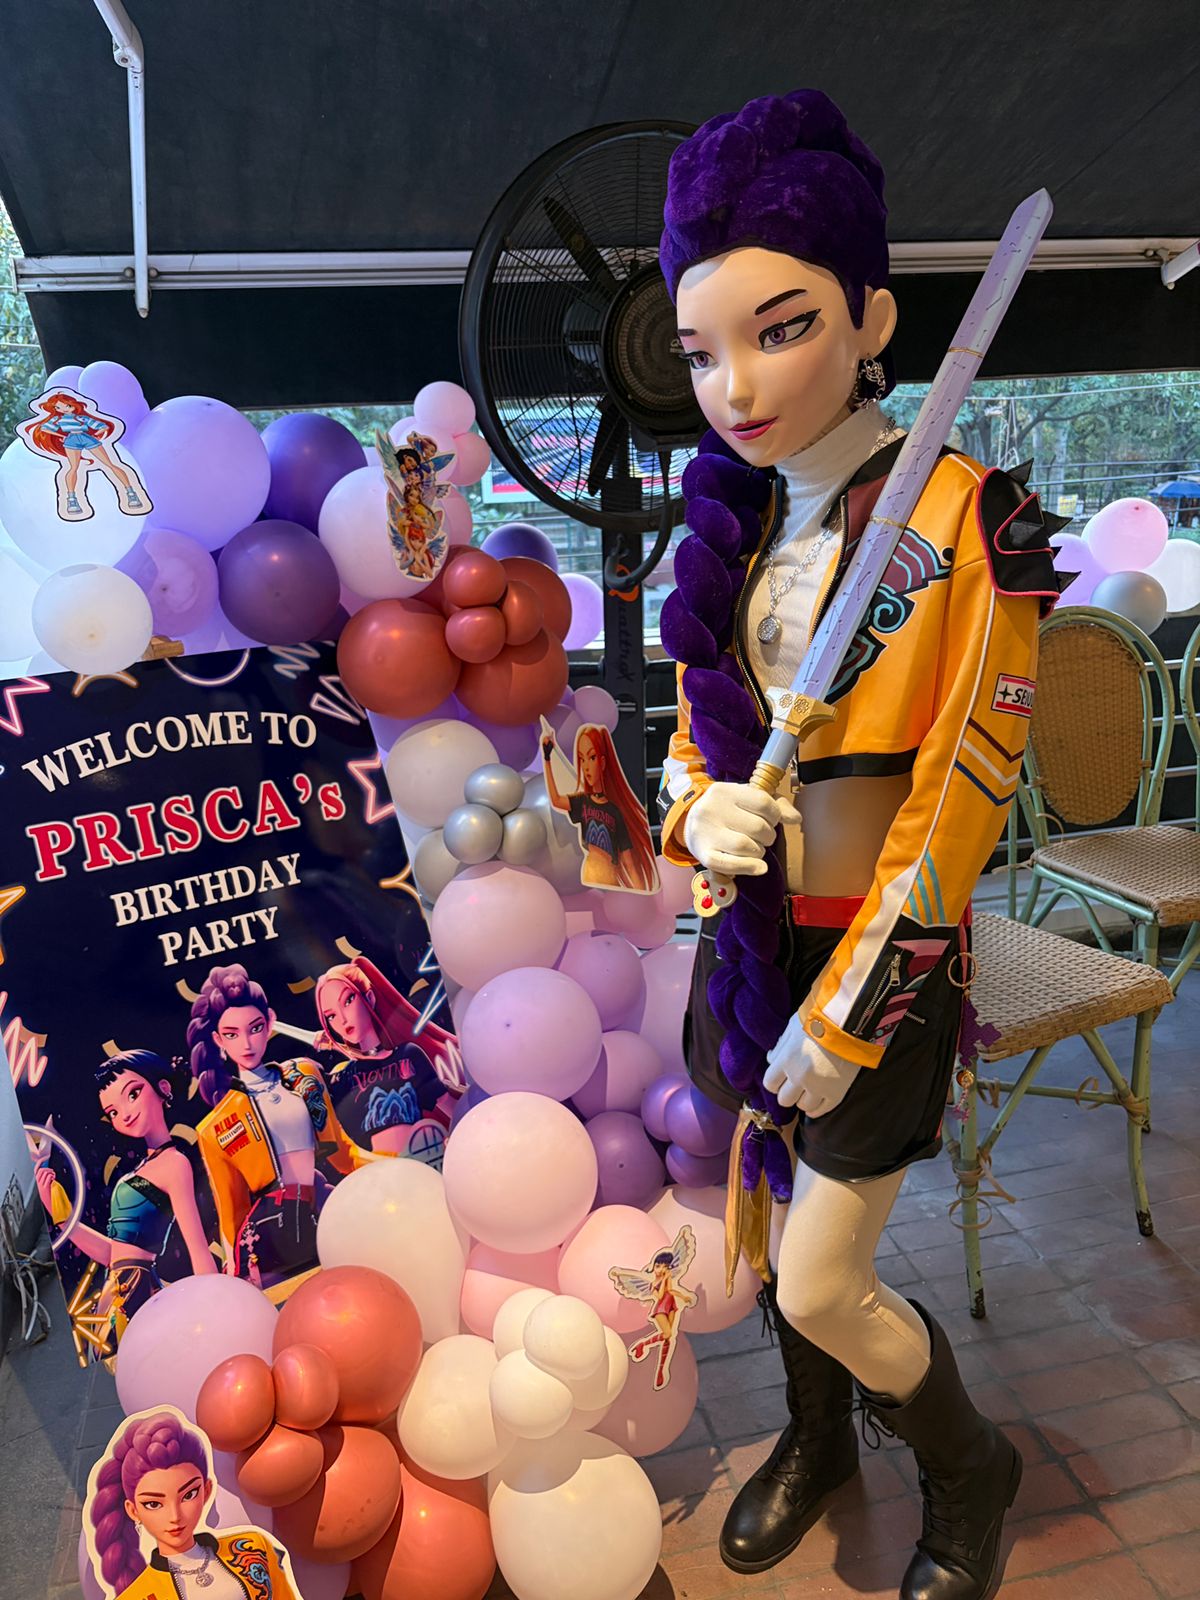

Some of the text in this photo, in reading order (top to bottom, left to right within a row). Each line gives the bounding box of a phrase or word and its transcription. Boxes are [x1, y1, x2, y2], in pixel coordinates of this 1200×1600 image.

[22, 711, 317, 793] WELCOME TO
[26, 773, 346, 881] PRISCA’s
[110, 852, 301, 927] BIRTHDAY
[158, 906, 280, 966] PARTY
